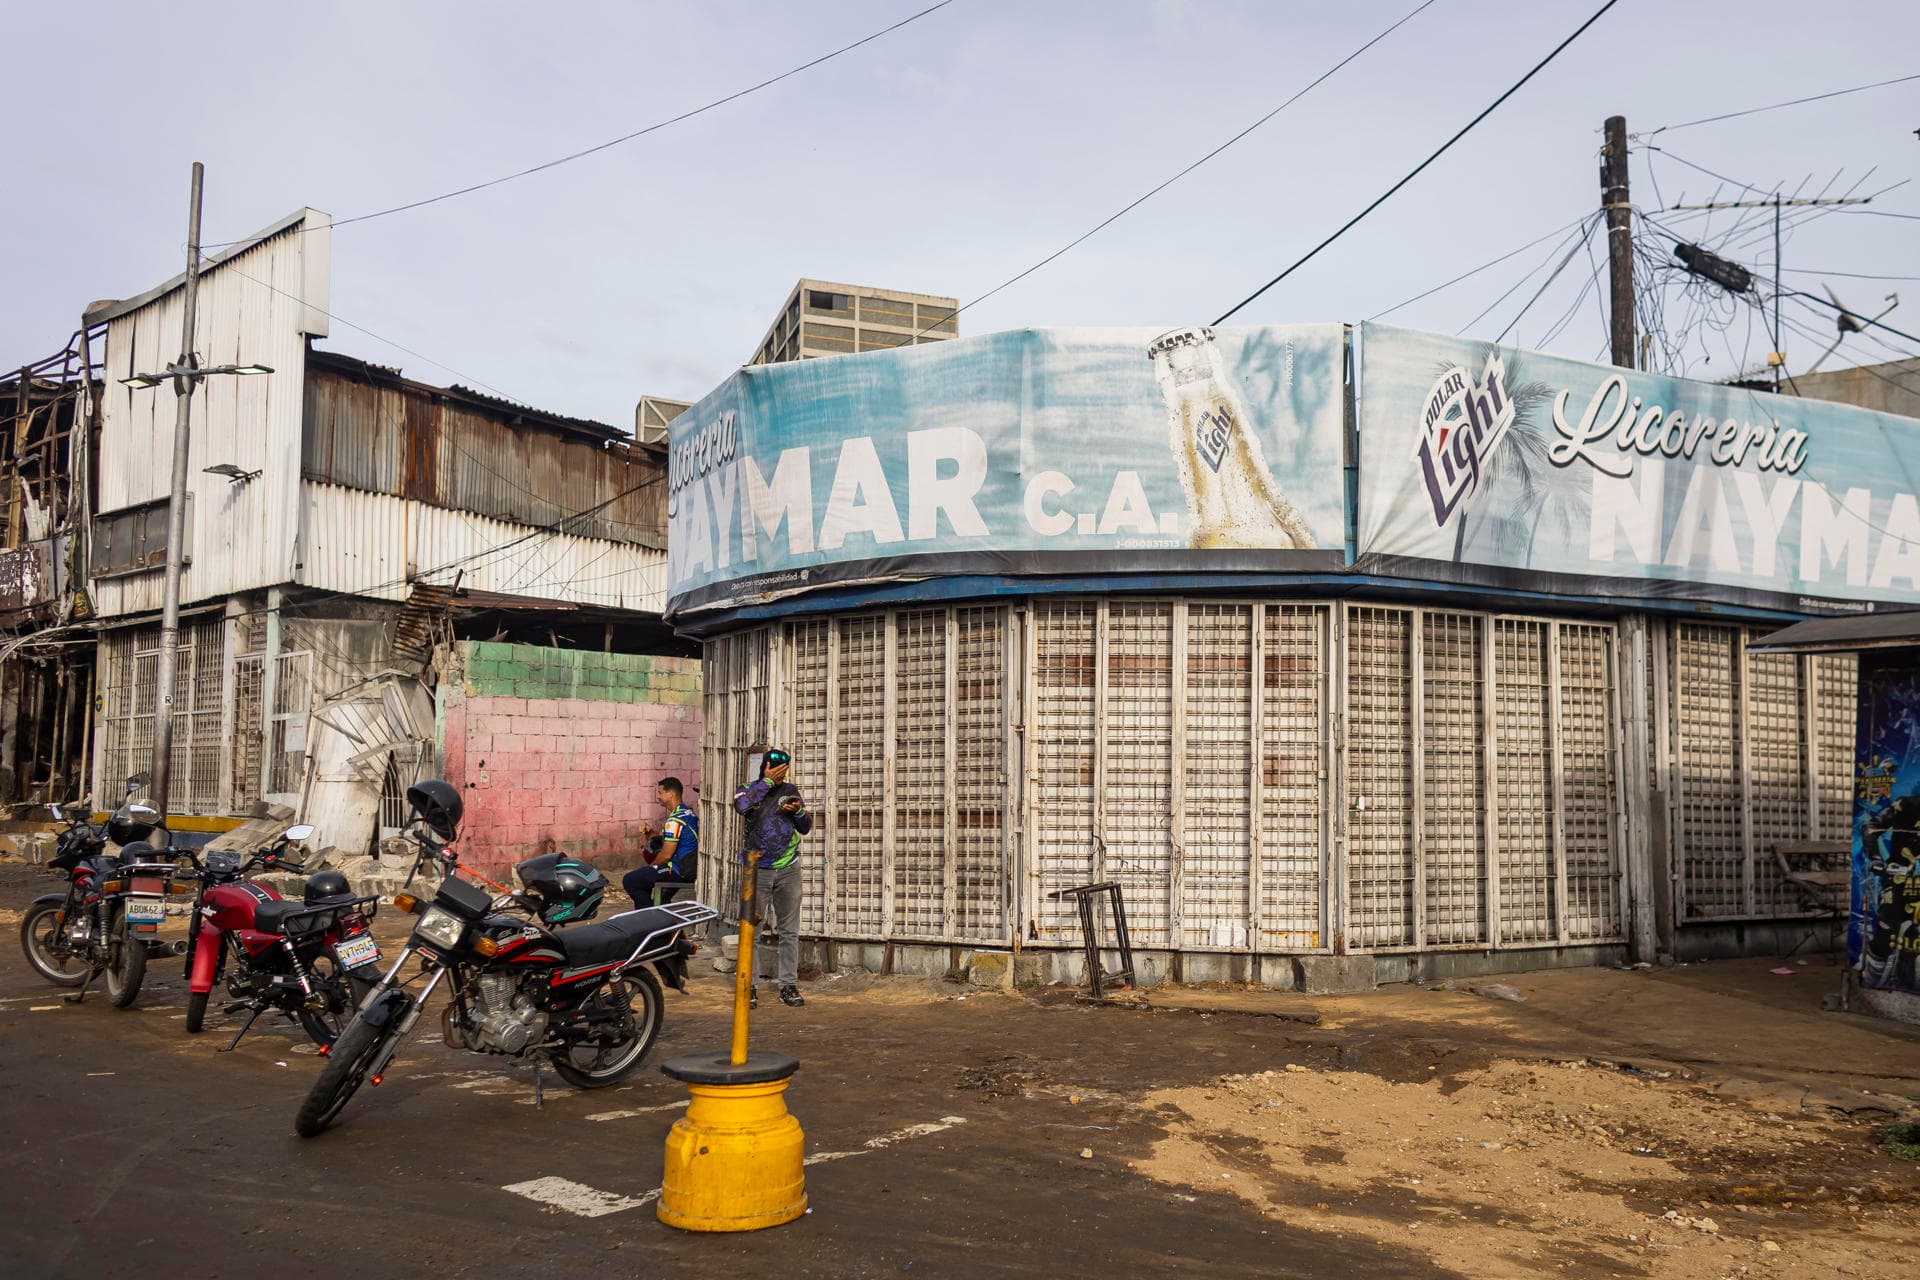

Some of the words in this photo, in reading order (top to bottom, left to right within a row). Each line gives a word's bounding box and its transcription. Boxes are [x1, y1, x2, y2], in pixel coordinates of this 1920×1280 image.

[1196, 406, 1235, 473] Light
[1426, 373, 1465, 439] POLAR
[1549, 374, 1808, 479] Licoreria
[1418, 369, 1509, 527] Light
[1023, 470, 1178, 536] C.A.
